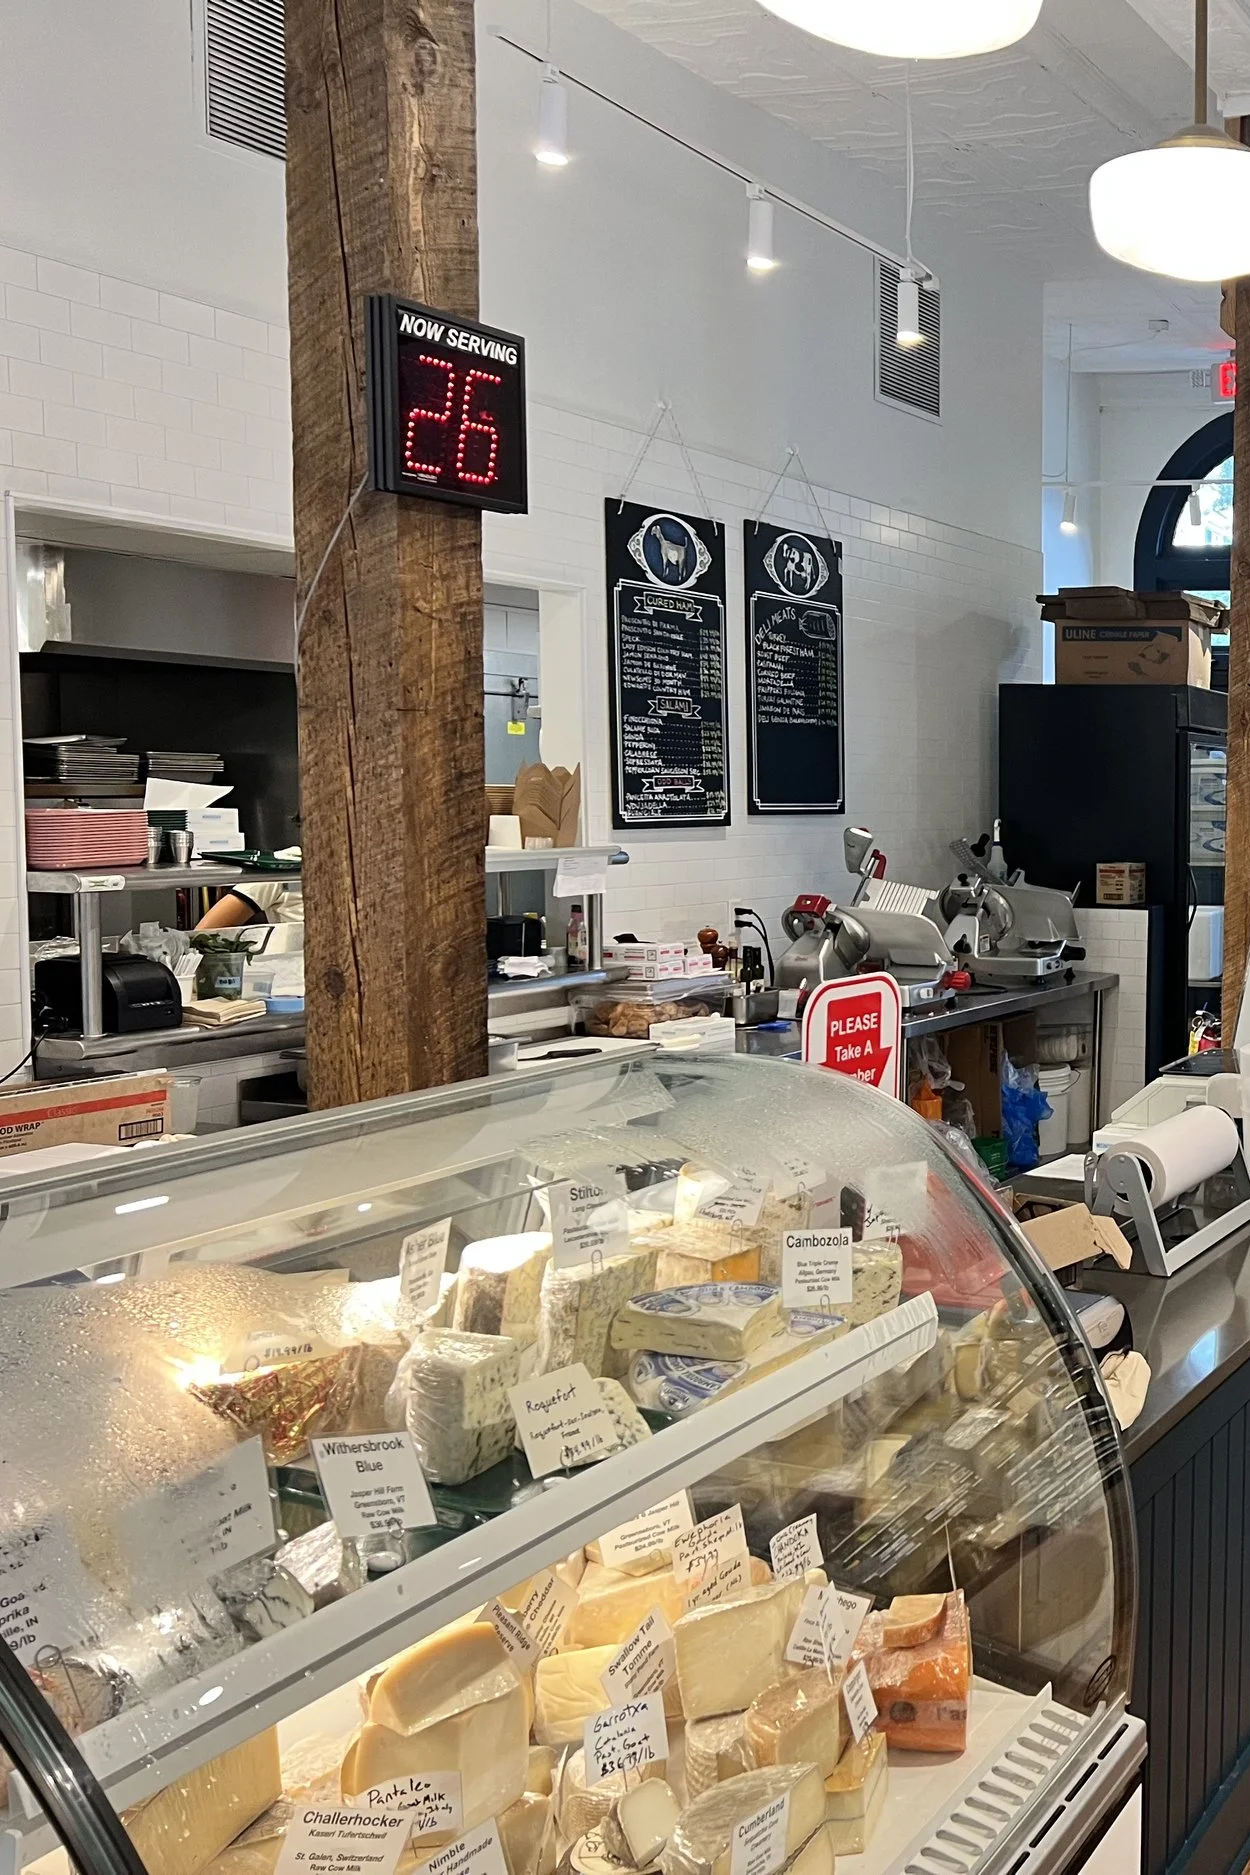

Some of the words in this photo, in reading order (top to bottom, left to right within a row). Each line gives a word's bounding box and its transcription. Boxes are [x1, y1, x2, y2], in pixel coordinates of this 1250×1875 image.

[400, 313, 445, 342] NOW
[446, 328, 518, 366] SERVING
[404, 354, 502, 485] 26
[646, 596, 675, 609] CURED
[754, 620, 771, 645] DELI
[771, 607, 796, 625] MEATS
[621, 633, 640, 642] SPECK
[1065, 629, 1096, 640] ULINE
[762, 642, 780, 651] BLACK
[799, 649, 815, 658] HAM
[757, 678, 795, 687] MORTADELLA
[659, 699, 689, 713] SALAMI
[656, 777, 672, 785] ODD
[673, 777, 692, 786] BALLS
[830, 1012, 879, 1037] PLEASE
[834, 1043, 861, 1062] Take
[863, 1039, 873, 1056] A
[849, 1067, 877, 1083] ber
[47, 1104, 78, 1118] Classic
[15, 1122, 41, 1133] WRAP
[569, 1185, 607, 1202] Stilto
[786, 1233, 849, 1249] Cambozola
[525, 1383, 577, 1414] Roquefort
[322, 1437, 405, 1456] Withersbrook
[355, 1460, 384, 1473] Blue
[350, 1489, 373, 1498] Jasper
[374, 1486, 385, 1494] Hill
[386, 1485, 404, 1494] Farm
[354, 1498, 396, 1509] Greensboro,
[396, 1495, 406, 1504] VT
[648, 1506, 668, 1516] Jasper
[669, 1500, 680, 1508] Hill
[361, 1511, 375, 1519] Raw
[376, 1509, 391, 1517] Cow
[391, 1506, 405, 1514] Milk
[614, 1534, 652, 1550] Pasteurized
[719, 1559, 742, 1580] Gouda
[0, 1592, 26, 1608] Goa
[523, 1589, 539, 1618] berry
[529, 1576, 554, 1621] Cheddar
[25, 1615, 39, 1628] IN
[492, 1604, 516, 1634] Pleasant
[514, 1629, 531, 1651] Ridge
[608, 1635, 640, 1677] Swallow
[639, 1615, 655, 1635] Tail
[622, 1640, 652, 1675] Tomme
[593, 1702, 648, 1733] Garrotxa
[623, 1733, 650, 1750] Goat
[366, 1778, 431, 1809] Pantaleo
[302, 1810, 404, 1828] Challerhocker
[738, 1795, 785, 1838] Cumberland
[335, 1853, 385, 1863] Switzerland
[428, 1842, 466, 1873] Nimble
[446, 1837, 493, 1874] Handmade
[309, 1864, 327, 1872] Raw
[346, 1865, 362, 1873] Milk
